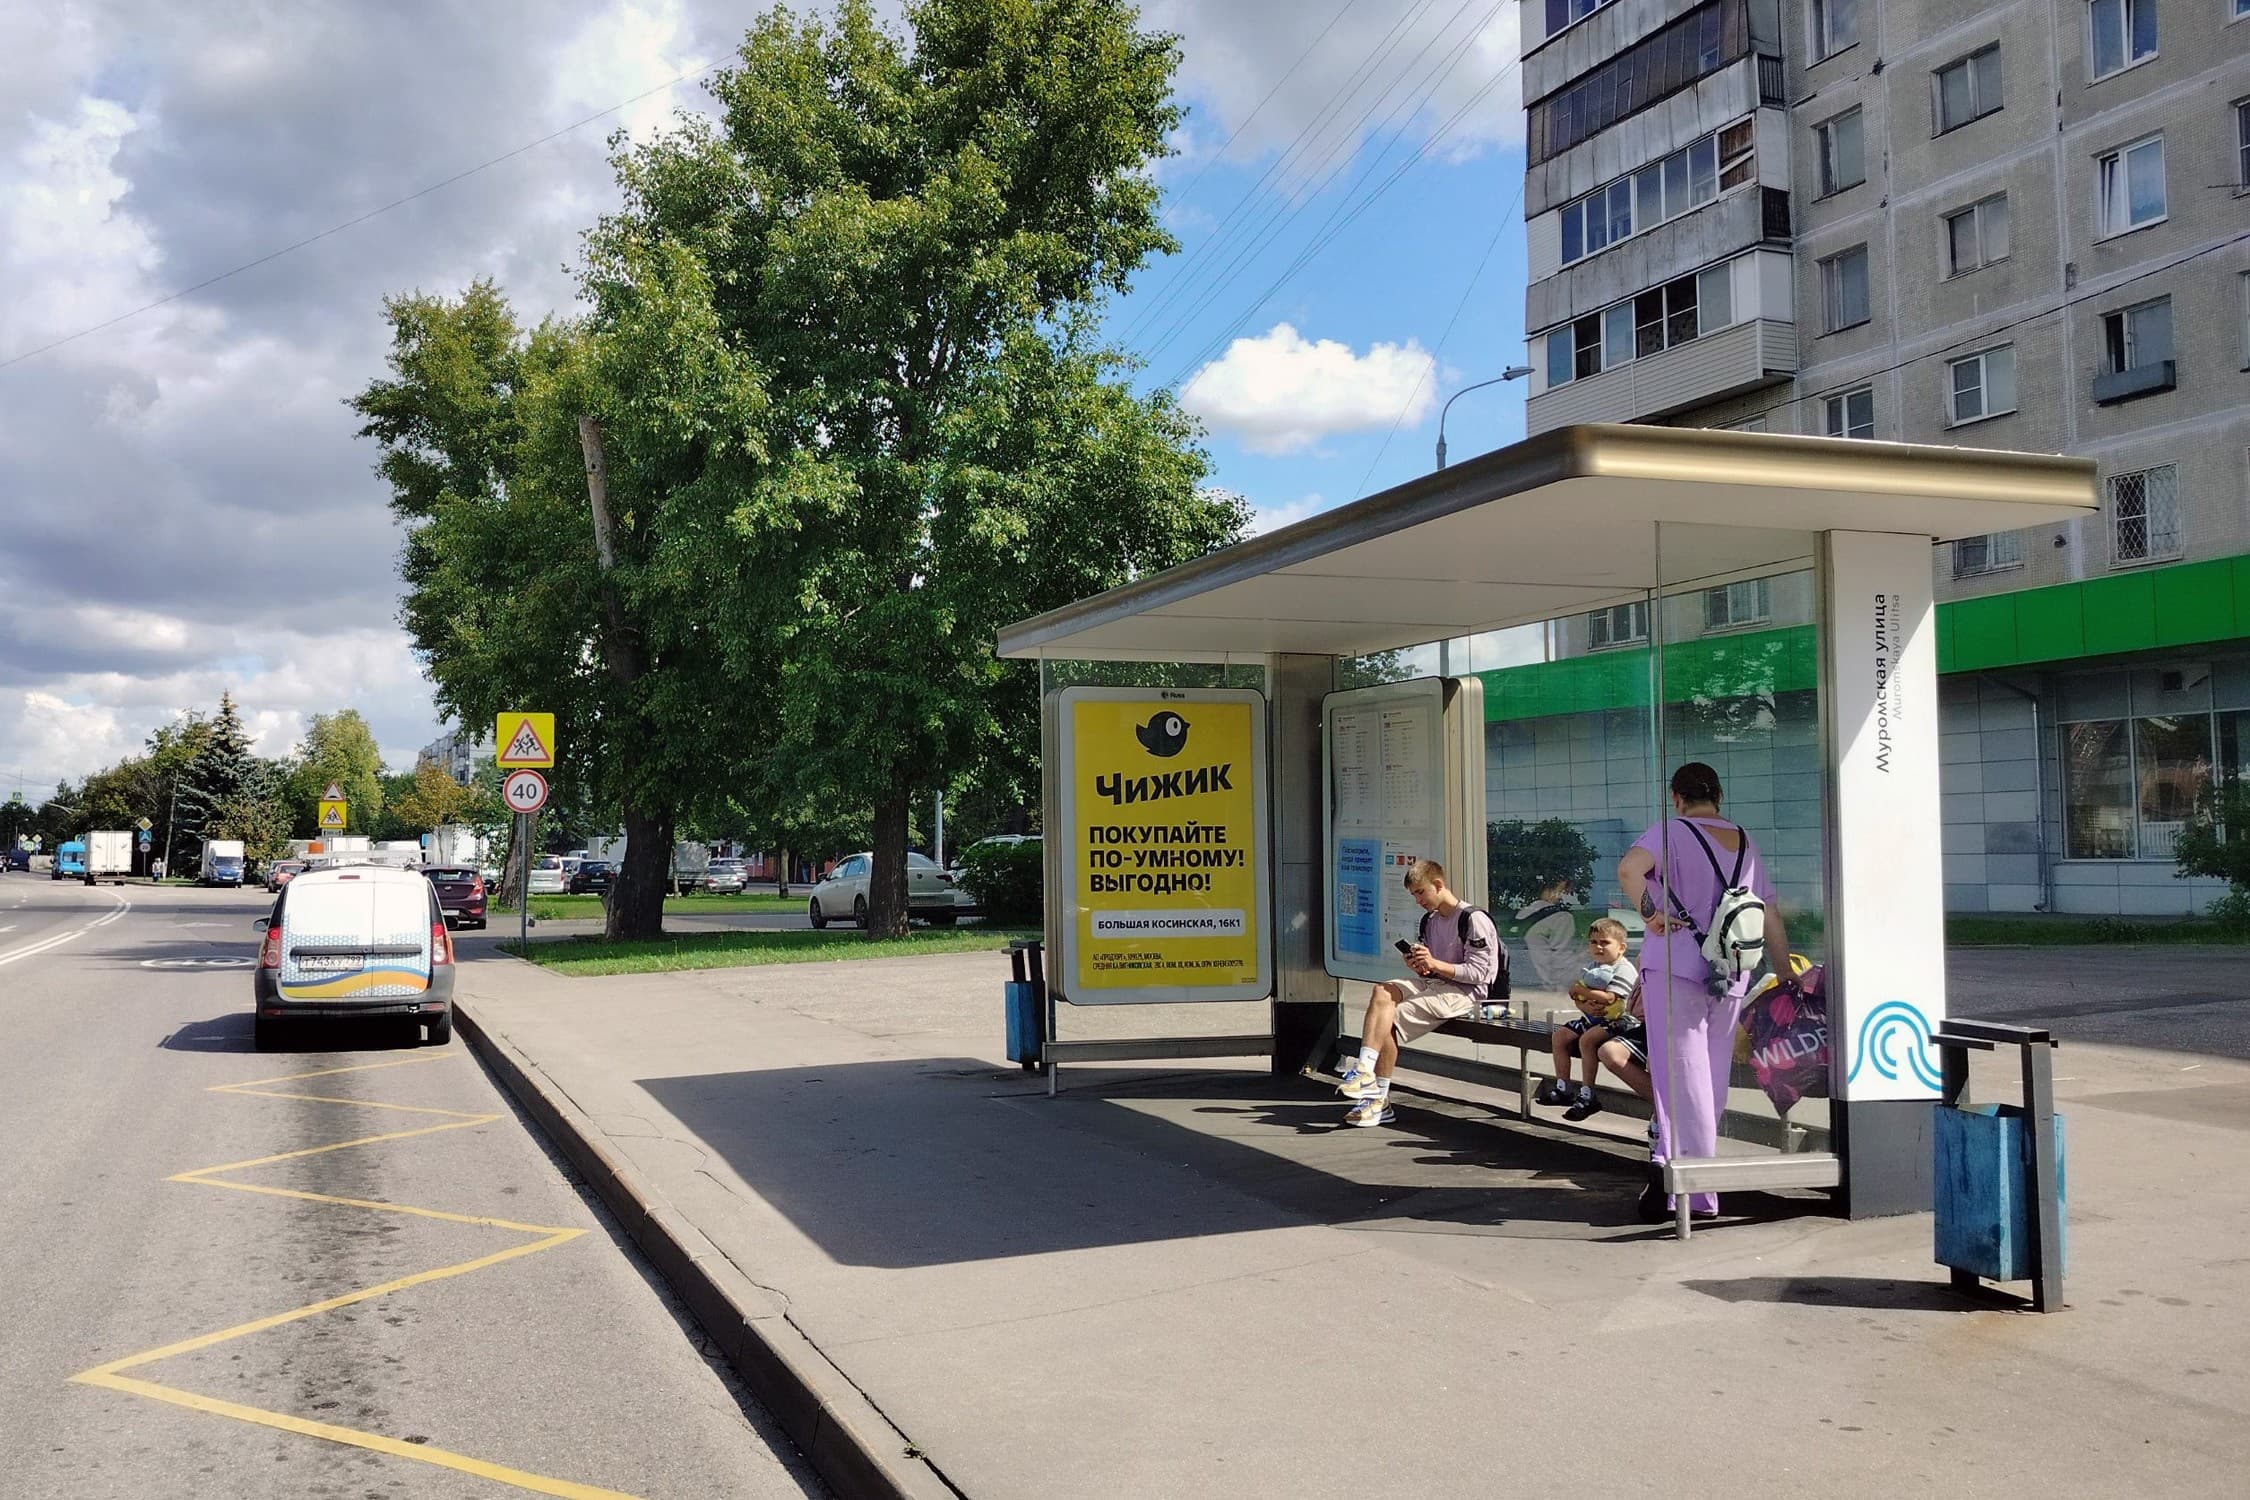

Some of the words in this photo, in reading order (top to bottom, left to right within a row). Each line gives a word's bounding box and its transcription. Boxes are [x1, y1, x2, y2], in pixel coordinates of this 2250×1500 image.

[1875, 594, 1888, 652] улица
[1890, 594, 1900, 632] Ulitsa
[1890, 635, 1902, 720] Muromskaya
[1876, 657, 1891, 773] Муромская
[512, 784, 538, 800] 40
[1096, 763, 1233, 806] Чижик
[1089, 820, 1227, 844] ПОКУПАЙТЕ
[1089, 849, 1245, 869] ПО-УМНОМУ!
[1090, 873, 1211, 895] ВЫГОДНО!
[1098, 920, 1150, 930] БОЛЬШАЯ
[1152, 919, 1217, 931] КОСИНСКАЯ,
[1218, 919, 1241, 929] 16К1
